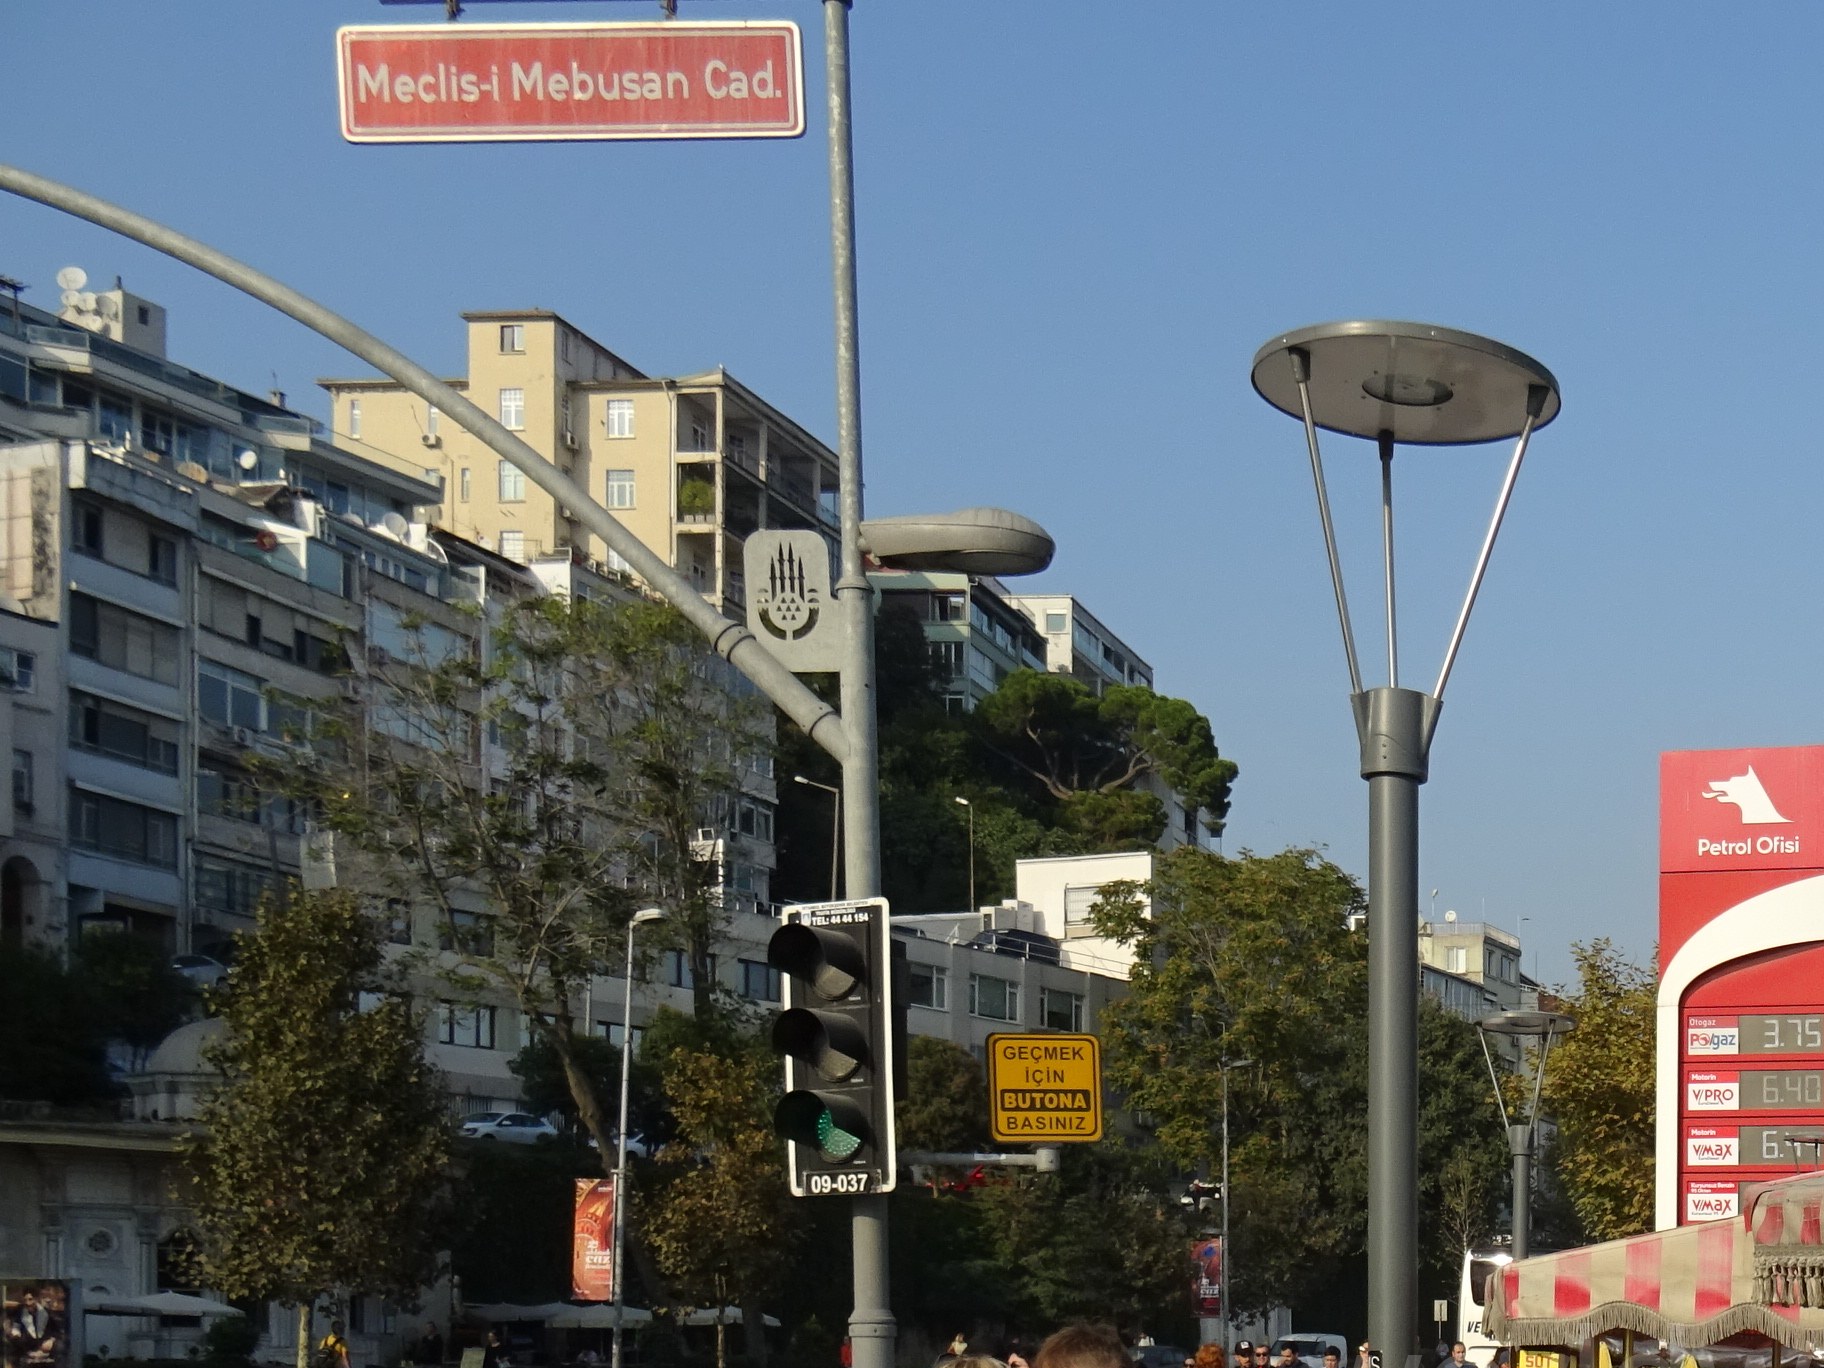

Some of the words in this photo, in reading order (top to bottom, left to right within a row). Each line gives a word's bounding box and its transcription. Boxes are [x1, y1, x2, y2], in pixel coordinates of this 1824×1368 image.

[356, 62, 499, 104] Meclis-i
[511, 60, 690, 103] Mebusan
[704, 58, 783, 101] Cad.
[1698, 838, 1751, 856] Petrol
[1756, 836, 1800, 854] Ofisi
[812, 916, 829, 926] TEL:
[830, 914, 841, 924] 44
[842, 913, 853, 923] 44
[854, 912, 869, 923] 154
[1689, 1018, 1716, 1028] Otogaz
[1763, 1019, 1821, 1048] 3.75
[1003, 1045, 1085, 1064] GEÇMEK
[1025, 1066, 1065, 1086] İÇİN
[1691, 1073, 1717, 1081] Motorin
[1762, 1075, 1821, 1103] 6.40
[1003, 1092, 1088, 1110] BUTONA
[1006, 1116, 1086, 1131] BASINIZ
[1691, 1128, 1716, 1136] Motorin
[811, 1173, 868, 1193] 09-037
